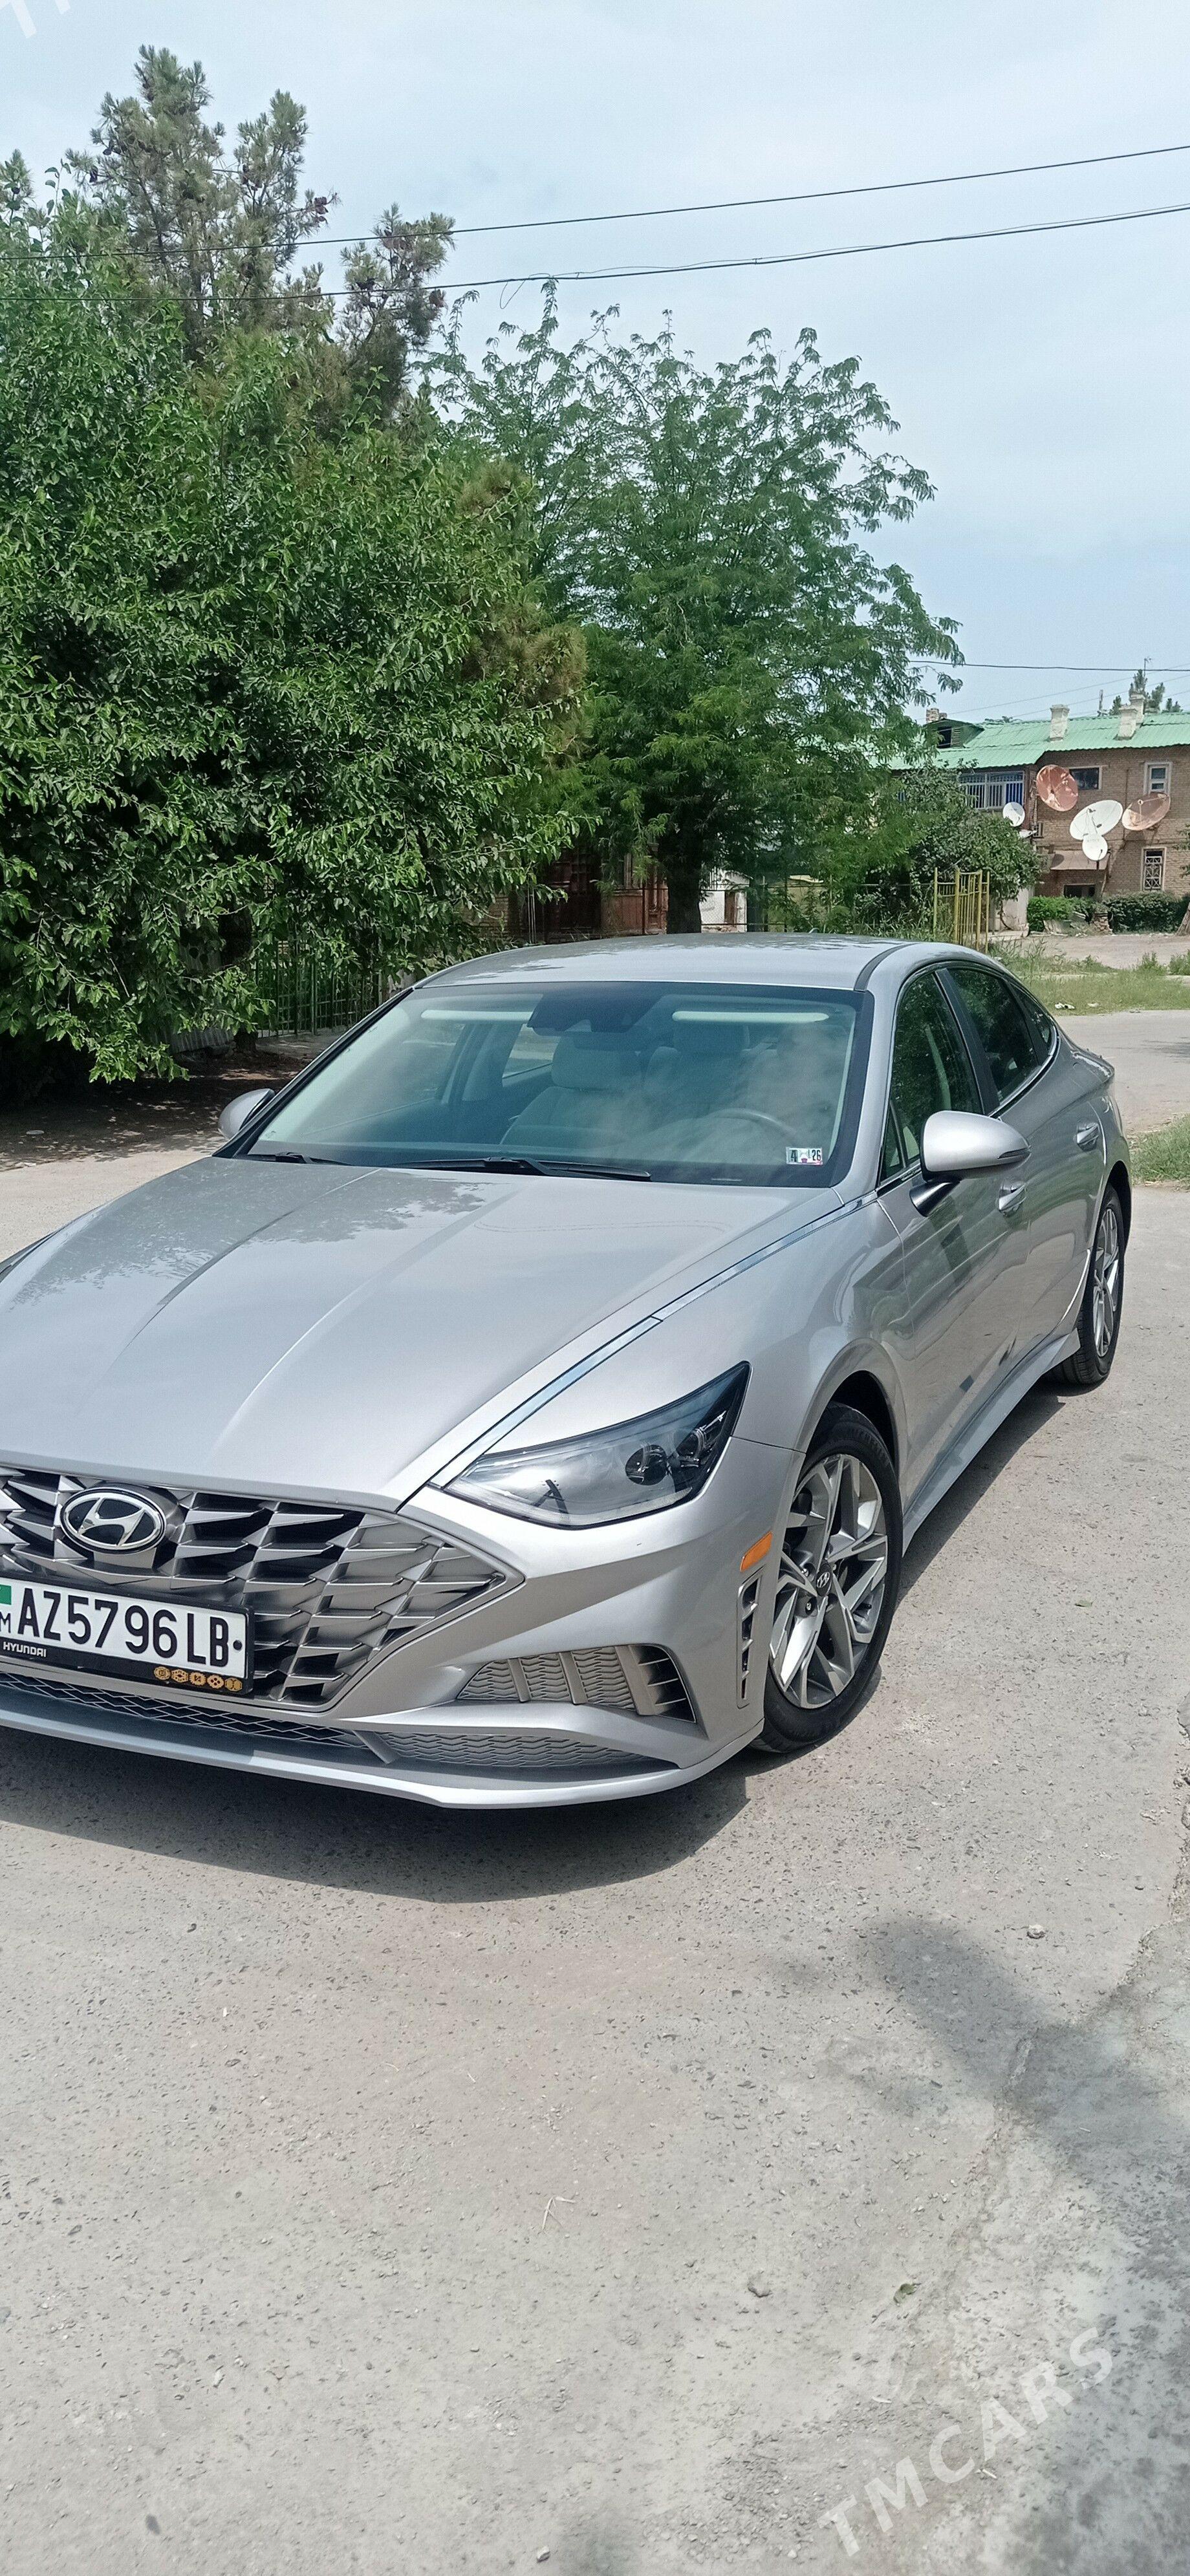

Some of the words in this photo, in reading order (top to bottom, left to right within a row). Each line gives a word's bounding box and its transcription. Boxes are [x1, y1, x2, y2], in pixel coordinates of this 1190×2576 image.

[812, 1150, 821, 1161] 26
[17, 1588, 229, 1667] AZ5796LB
[3, 1641, 47, 1657] HYUNDAI
